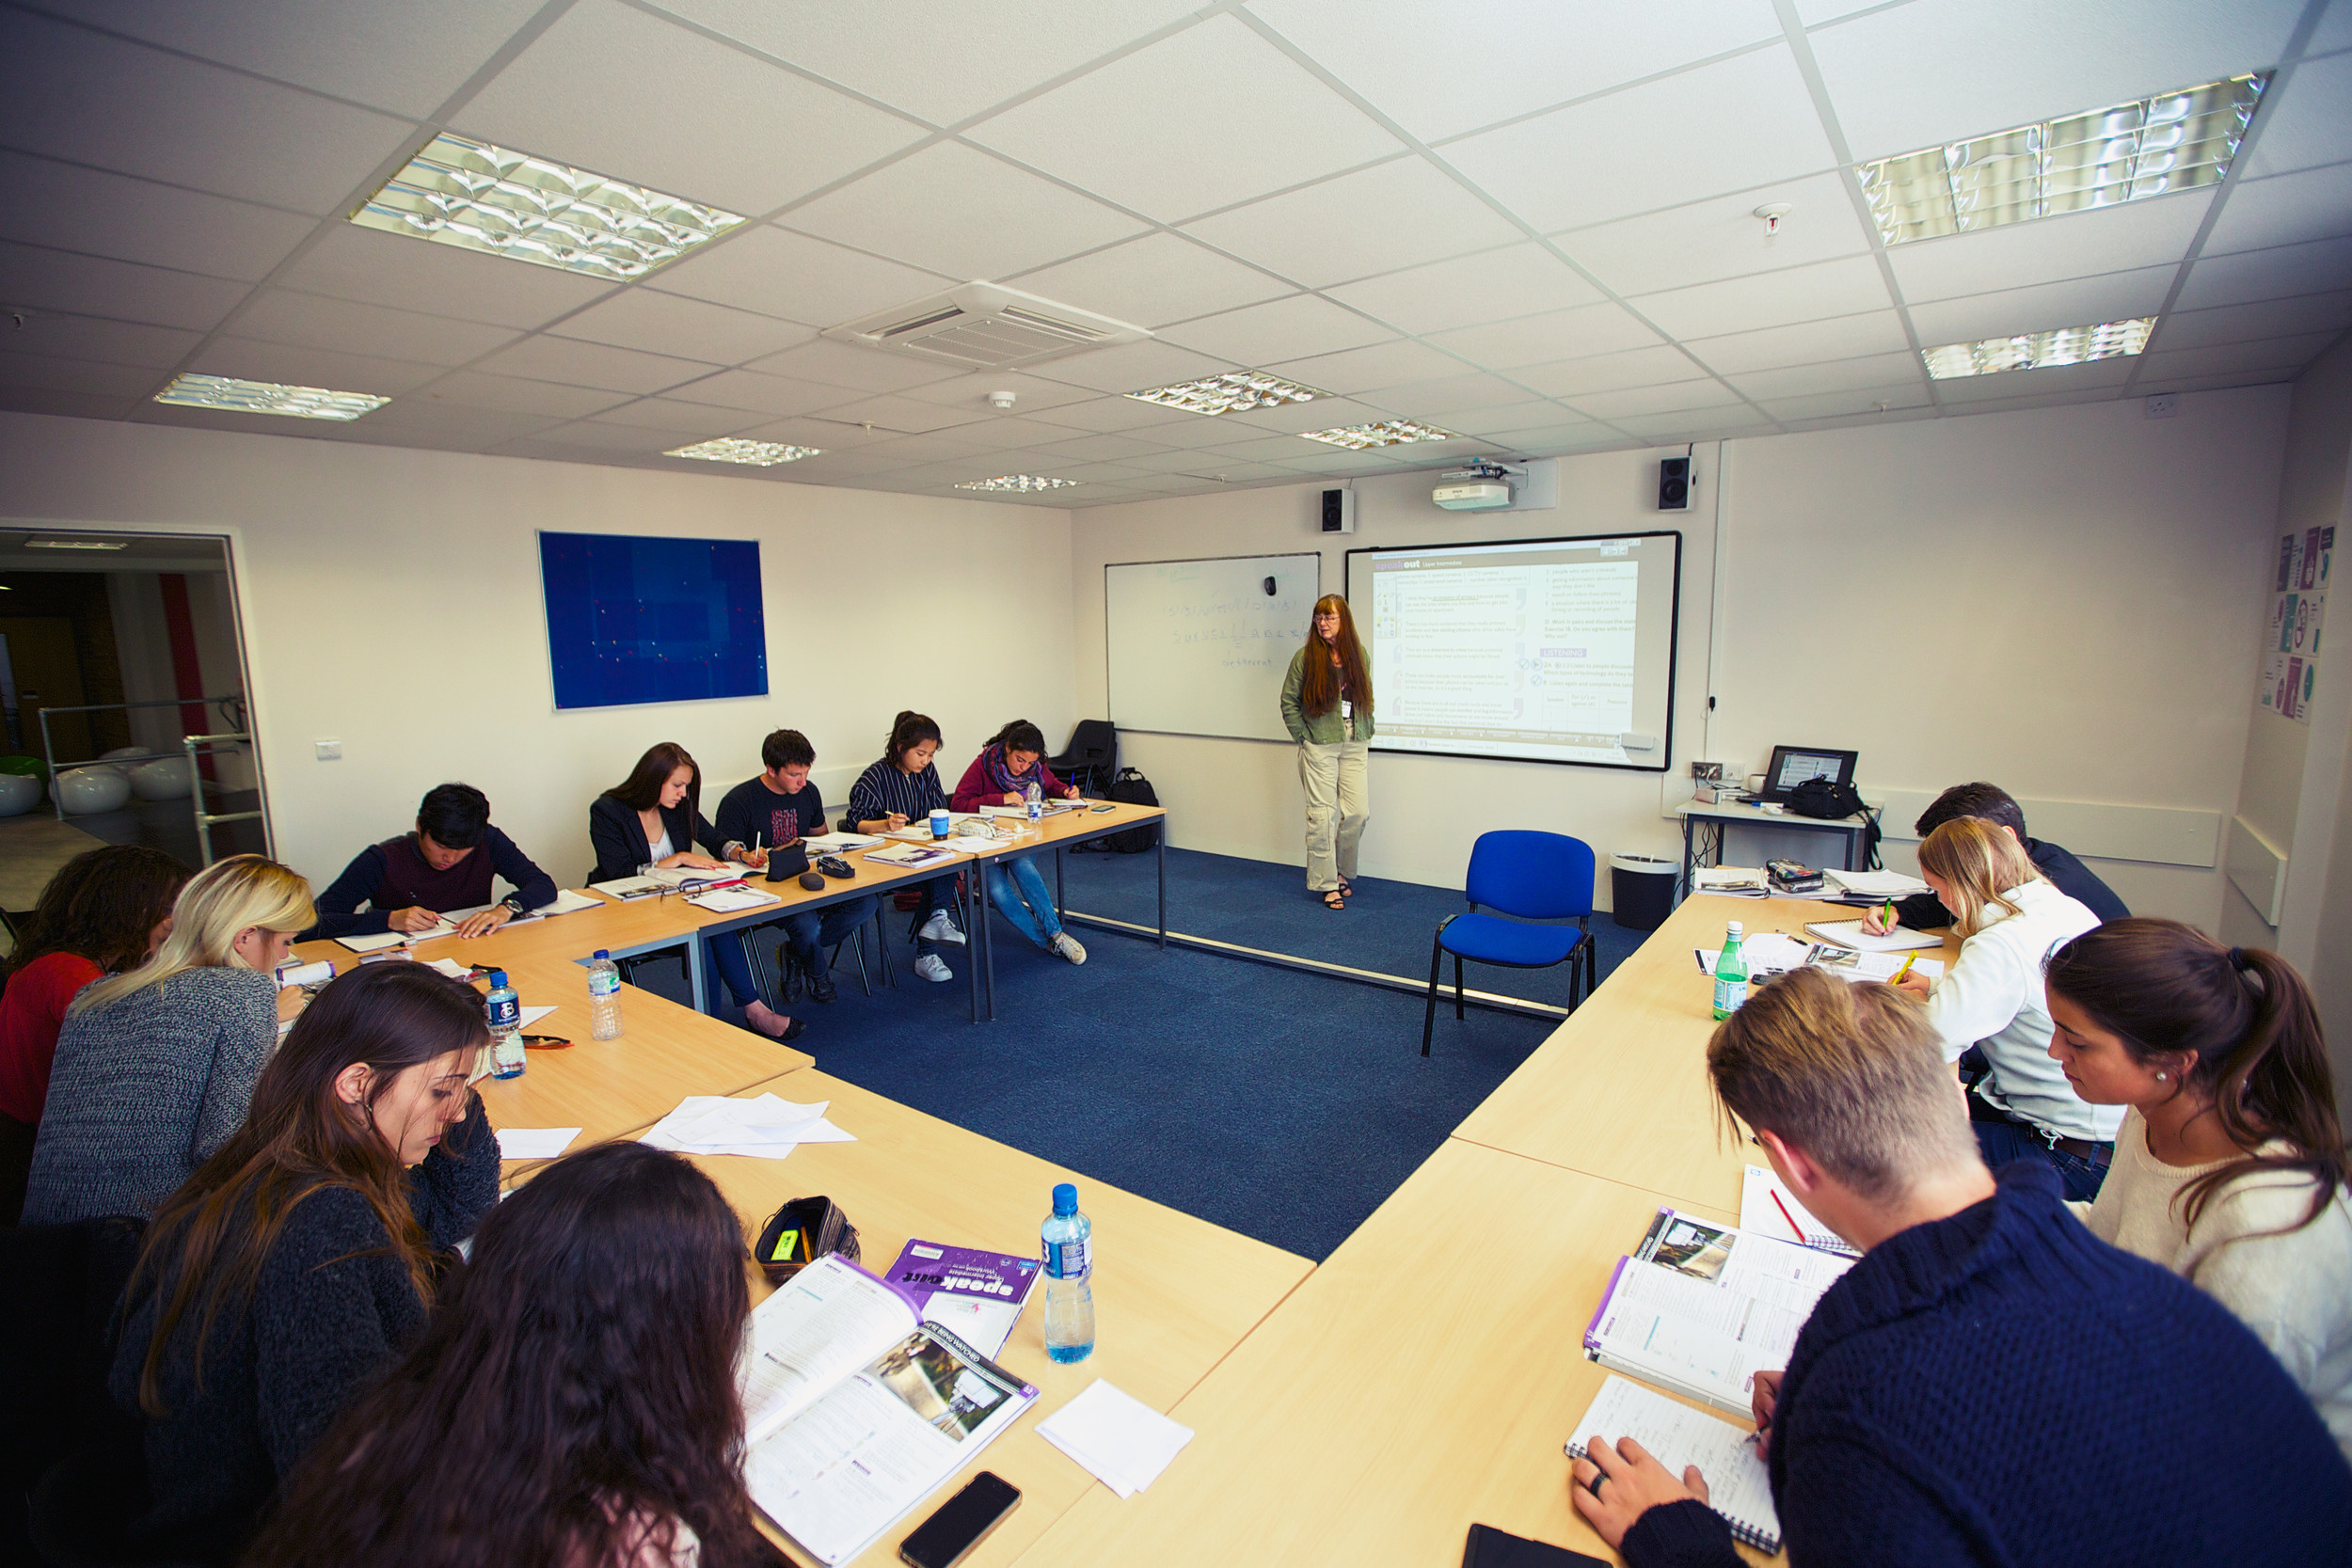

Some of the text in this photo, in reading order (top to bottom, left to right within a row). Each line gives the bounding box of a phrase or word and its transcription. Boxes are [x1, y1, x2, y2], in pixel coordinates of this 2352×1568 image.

[901, 1272, 1014, 1296] speakout
[948, 1269, 985, 1279] Intermediate
[937, 1326, 954, 1342] BEING
[953, 1338, 980, 1362] WATCHED
